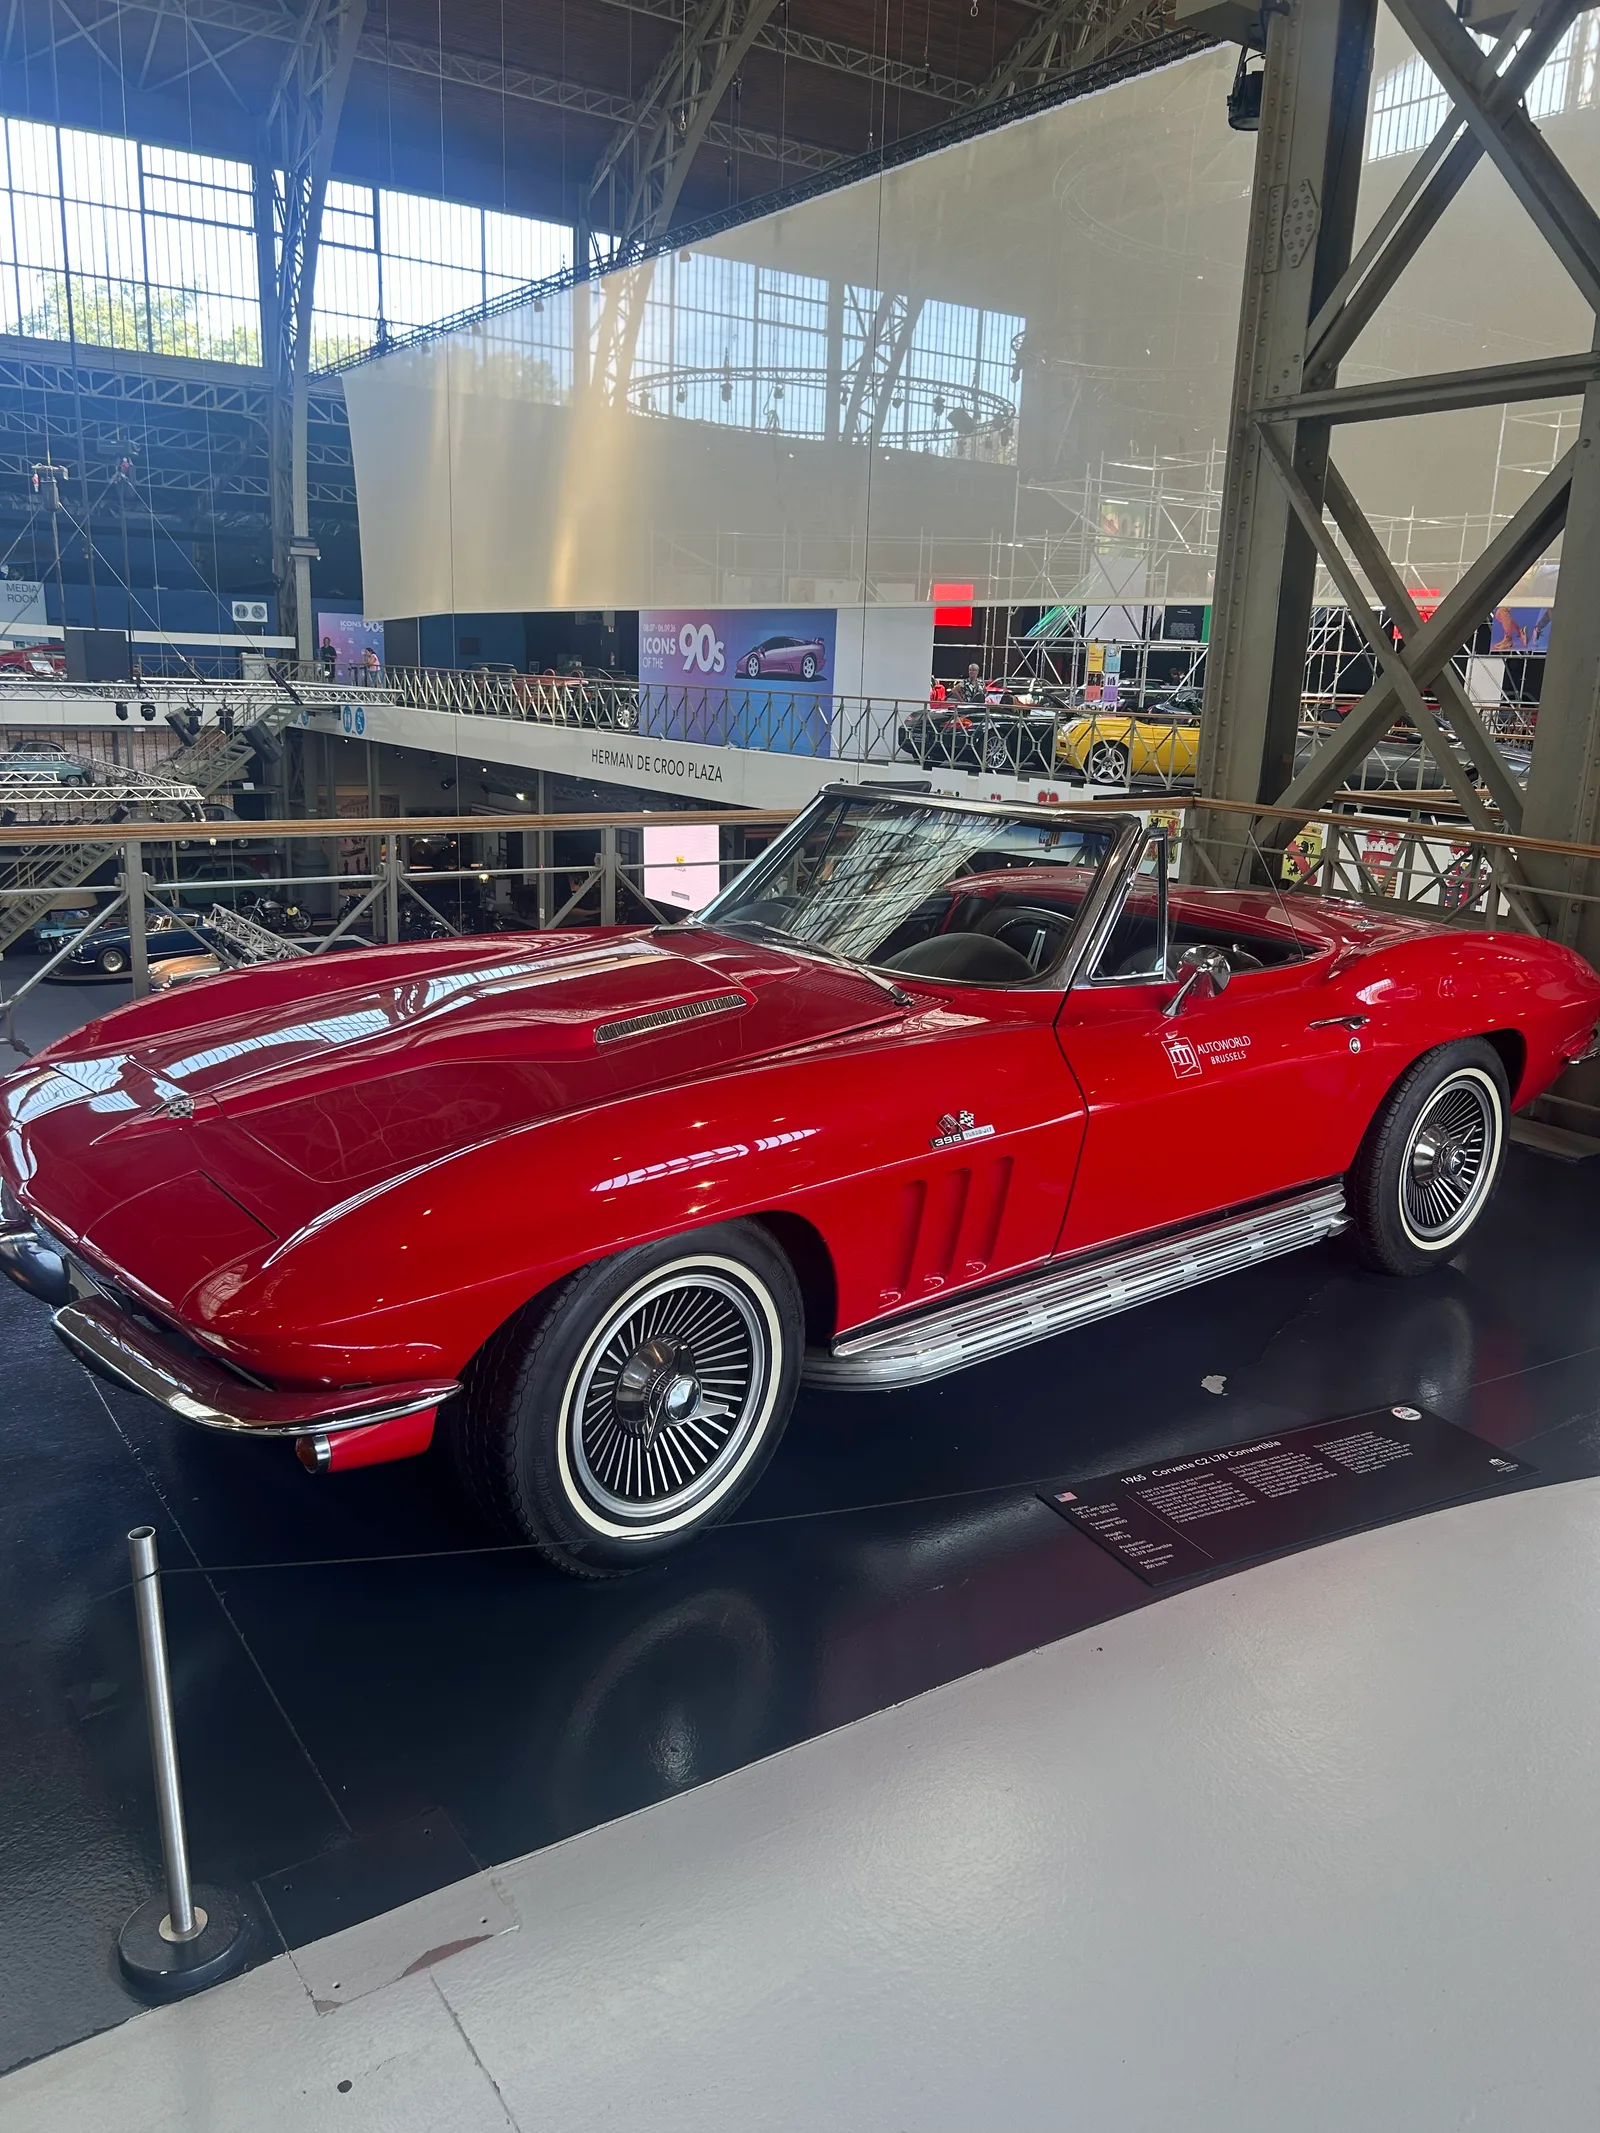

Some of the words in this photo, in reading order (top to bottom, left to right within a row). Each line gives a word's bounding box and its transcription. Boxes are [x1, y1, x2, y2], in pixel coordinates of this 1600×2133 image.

[6, 583, 38, 593] MEDIA
[7, 593, 39, 604] ROOM
[363, 621, 384, 633] 90s
[643, 637, 676, 655] ICONS
[679, 623, 726, 673] 90s
[642, 657, 652, 668] OF
[652, 657, 664, 669] THE
[591, 749, 634, 769] HERMAN
[637, 754, 650, 772] DE
[653, 757, 685, 777] CROO
[688, 762, 723, 782] PLAZA
[1196, 1035, 1251, 1055] AUTOWORLD
[1210, 1050, 1247, 1065] BRUSSELS
[934, 1133, 962, 1147] 396
[1121, 1473, 1147, 1486] 1965
[1151, 1462, 1195, 1477] Corvette
[1194, 1457, 1211, 1467] C2
[1209, 1453, 1229, 1463] L78
[1228, 1440, 1282, 1458] Convertible
